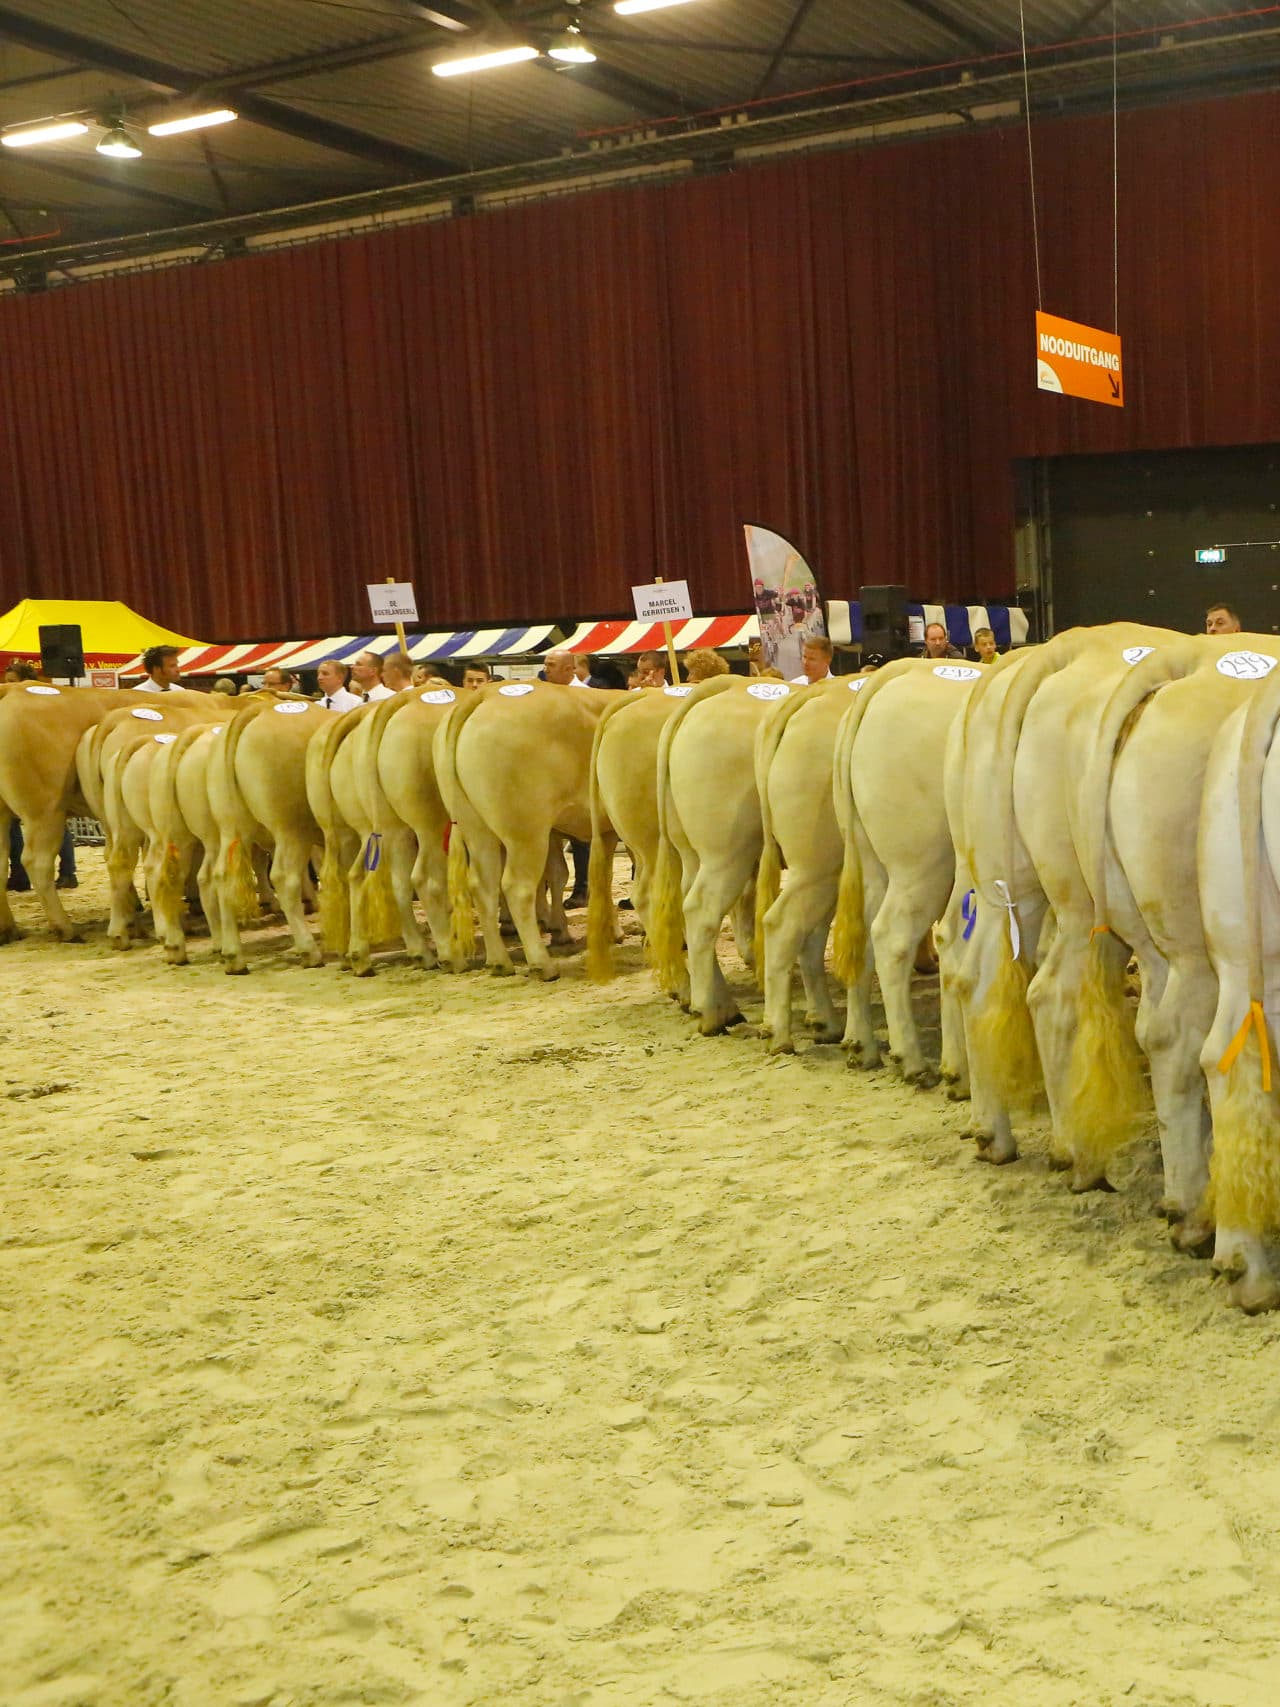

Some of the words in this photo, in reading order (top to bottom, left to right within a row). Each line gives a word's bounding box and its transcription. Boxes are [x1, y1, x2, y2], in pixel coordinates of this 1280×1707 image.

[1040, 333, 1120, 371] NOODUITGANG
[648, 598, 677, 608] MARCEL
[642, 606, 680, 617] GERRITSEN
[1220, 654, 1271, 675] 299
